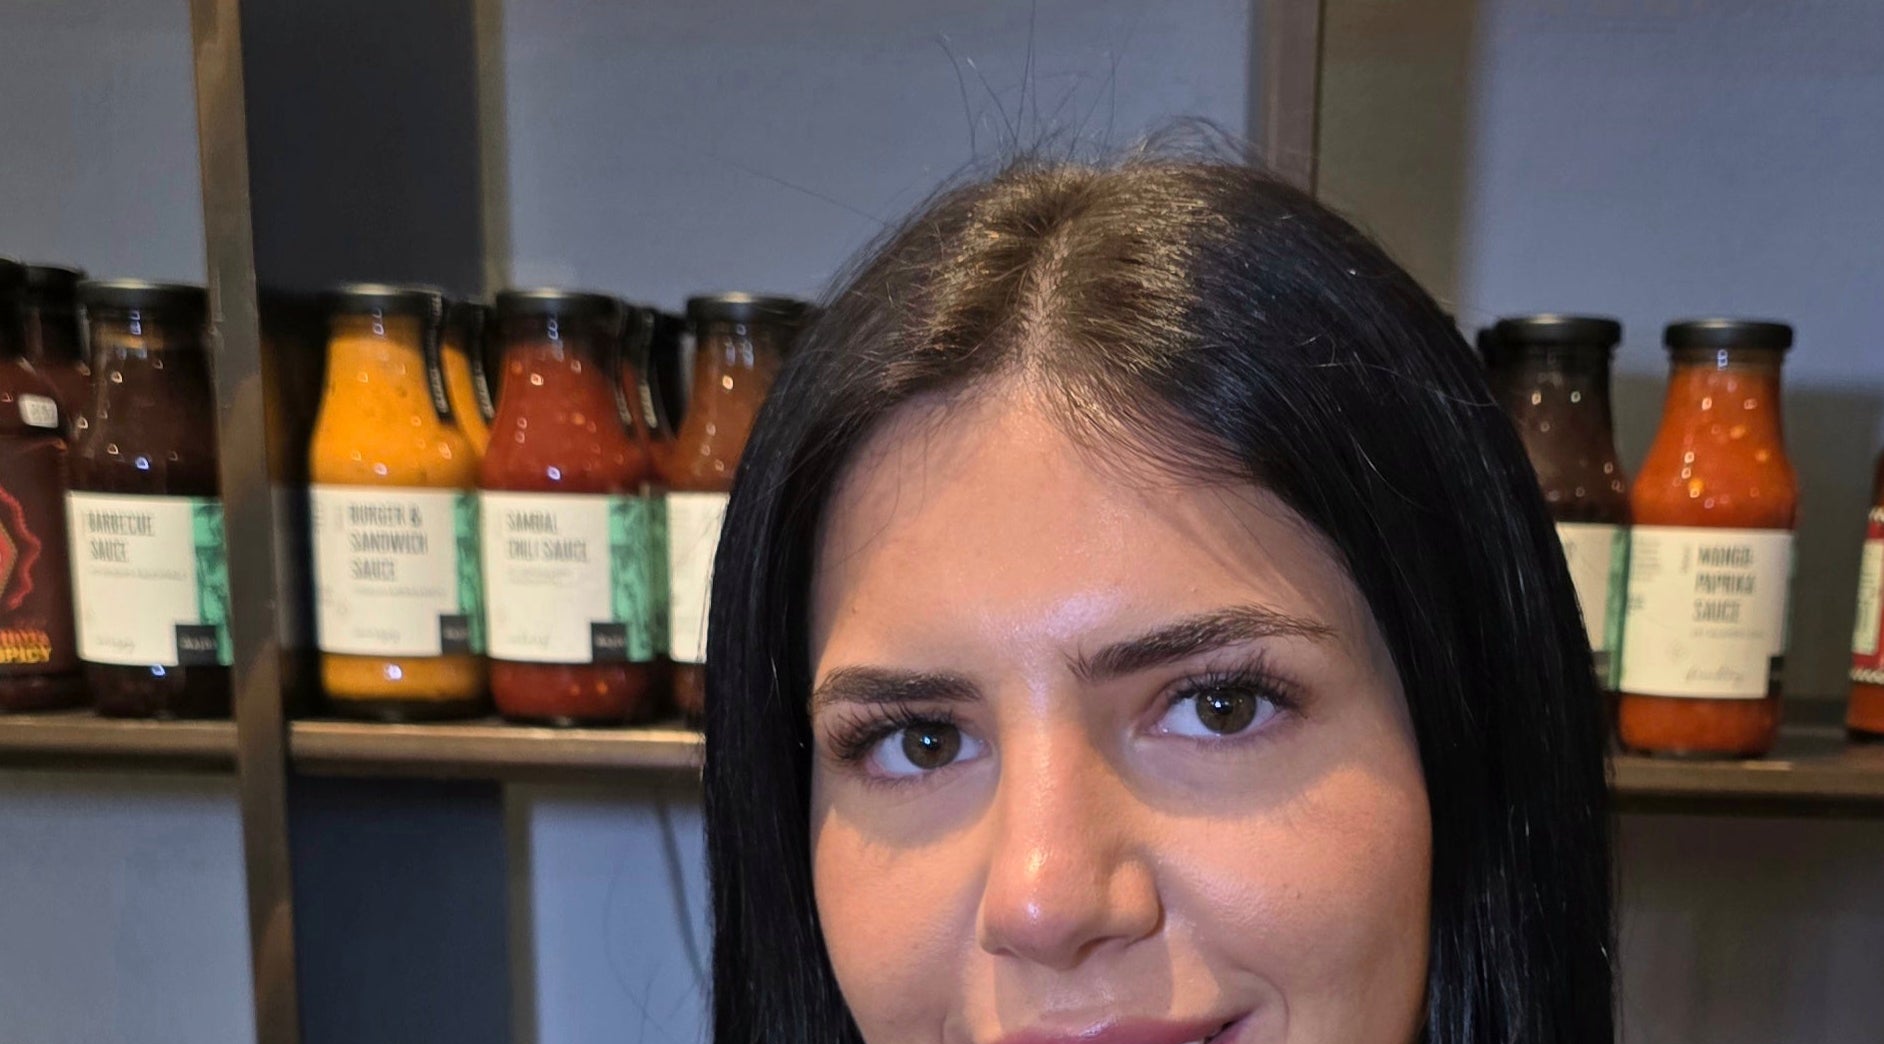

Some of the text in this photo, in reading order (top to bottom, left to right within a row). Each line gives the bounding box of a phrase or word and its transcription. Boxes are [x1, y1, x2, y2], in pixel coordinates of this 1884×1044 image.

[88, 513, 156, 536] BARBECUE
[349, 506, 405, 526] BURGER
[506, 511, 558, 533] SAMBAL
[90, 540, 130, 562] SAUCE
[351, 531, 429, 555] SANDWICH
[352, 559, 395, 581] SAUCE
[1694, 573, 1756, 595] PAPRIKA
[1692, 599, 1741, 624] SAUCE
